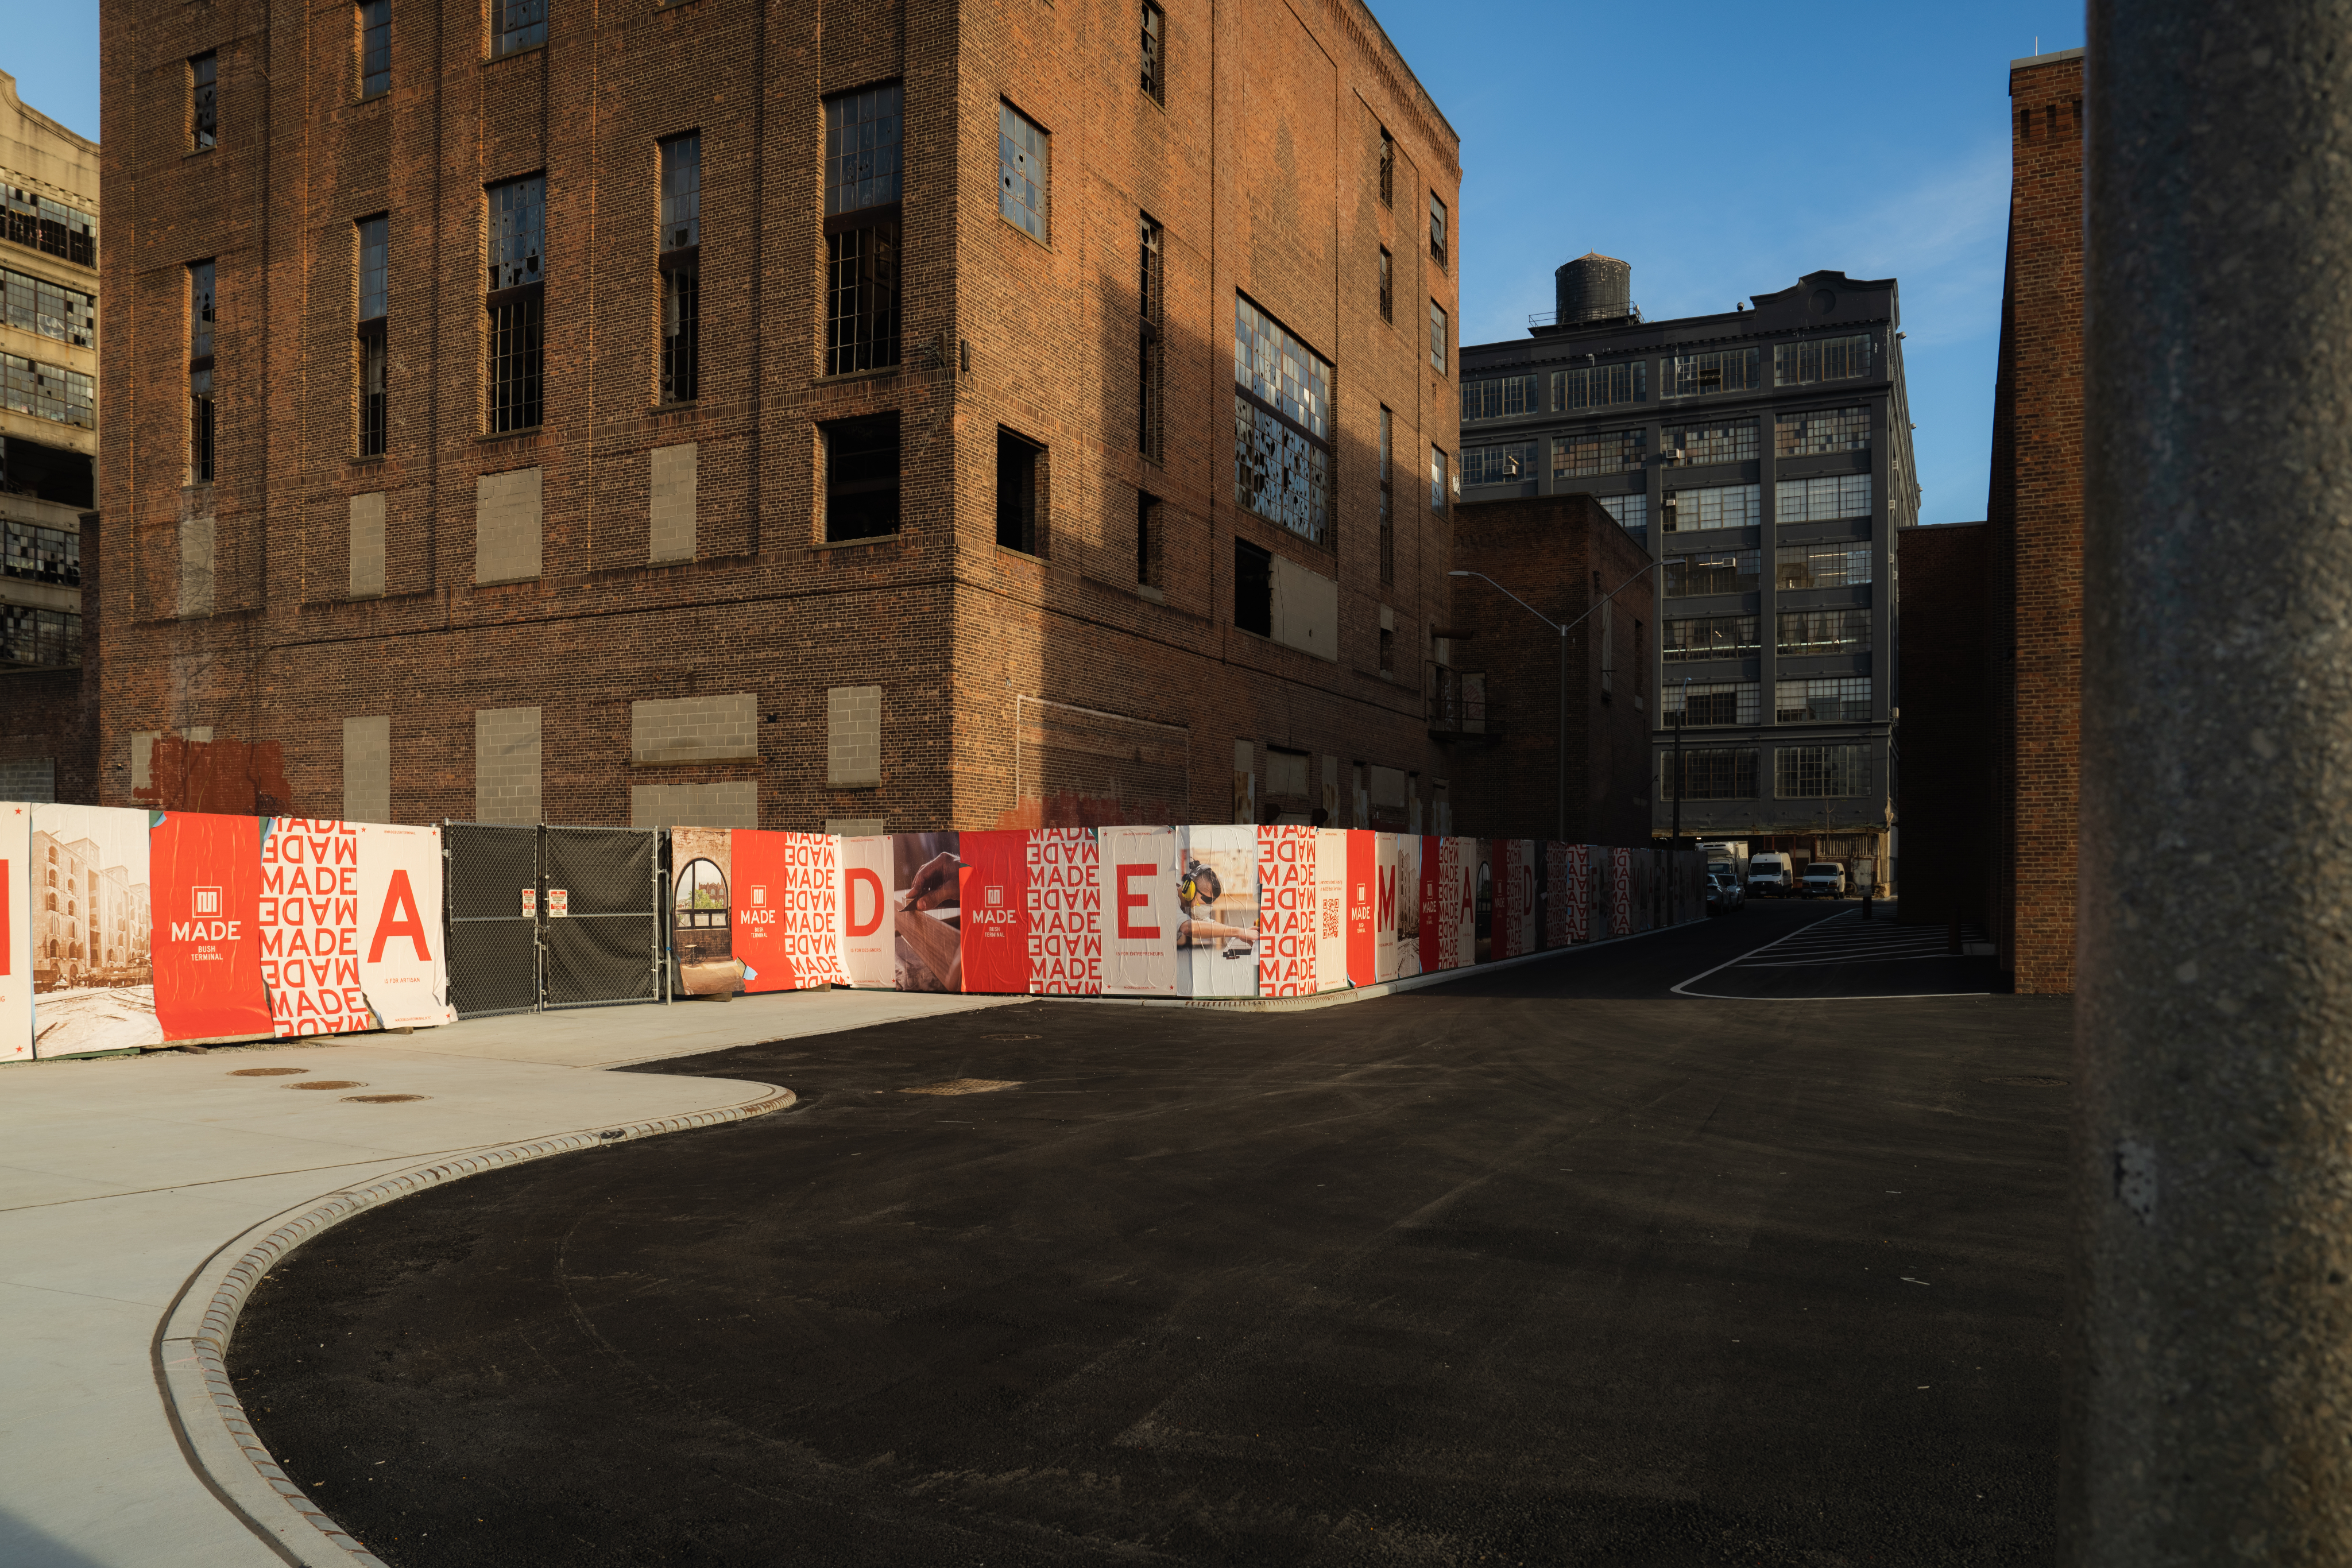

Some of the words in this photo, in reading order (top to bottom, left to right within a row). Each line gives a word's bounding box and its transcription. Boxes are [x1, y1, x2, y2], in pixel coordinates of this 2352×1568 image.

[262, 835, 357, 865] MADE
[785, 845, 834, 867] MADE
[1027, 842, 1099, 864] MADE
[1258, 840, 1315, 862] MADE
[260, 866, 357, 895] MADE
[786, 868, 834, 889] MADE
[1027, 865, 1099, 887] MADE
[1258, 864, 1315, 886] MADE
[1439, 865, 1459, 882] MADE
[1027, 889, 1100, 910] MADE
[1260, 888, 1315, 910] MADE
[1378, 865, 1395, 932] M
[1460, 866, 1473, 924] A
[1523, 865, 1532, 916] D
[1591, 867, 1597, 910] E
[260, 897, 357, 926] MADE
[785, 891, 835, 911] MADE
[845, 868, 884, 936] D
[1116, 864, 1160, 939] E
[1423, 900, 1436, 913] MADE
[1439, 902, 1459, 920] MADE
[1495, 897, 1504, 908] MADE
[368, 869, 432, 963] A
[741, 910, 775, 924] MADE
[785, 912, 834, 932] MADE
[973, 910, 1016, 923] MADE
[1028, 912, 1100, 934] MADE
[1260, 911, 1315, 934] MADE
[1352, 906, 1370, 920] MADE
[172, 921, 241, 942] MADE
[260, 928, 357, 958] MADE
[785, 934, 835, 955] MADE
[1028, 935, 1101, 956] MADE
[1260, 934, 1315, 958] MADE
[1439, 939, 1458, 958] MADE
[261, 958, 359, 989] MADE
[787, 955, 842, 975] MADE
[1028, 958, 1101, 979] MADE
[1259, 958, 1316, 981] MADE
[270, 988, 369, 1017] MADE
